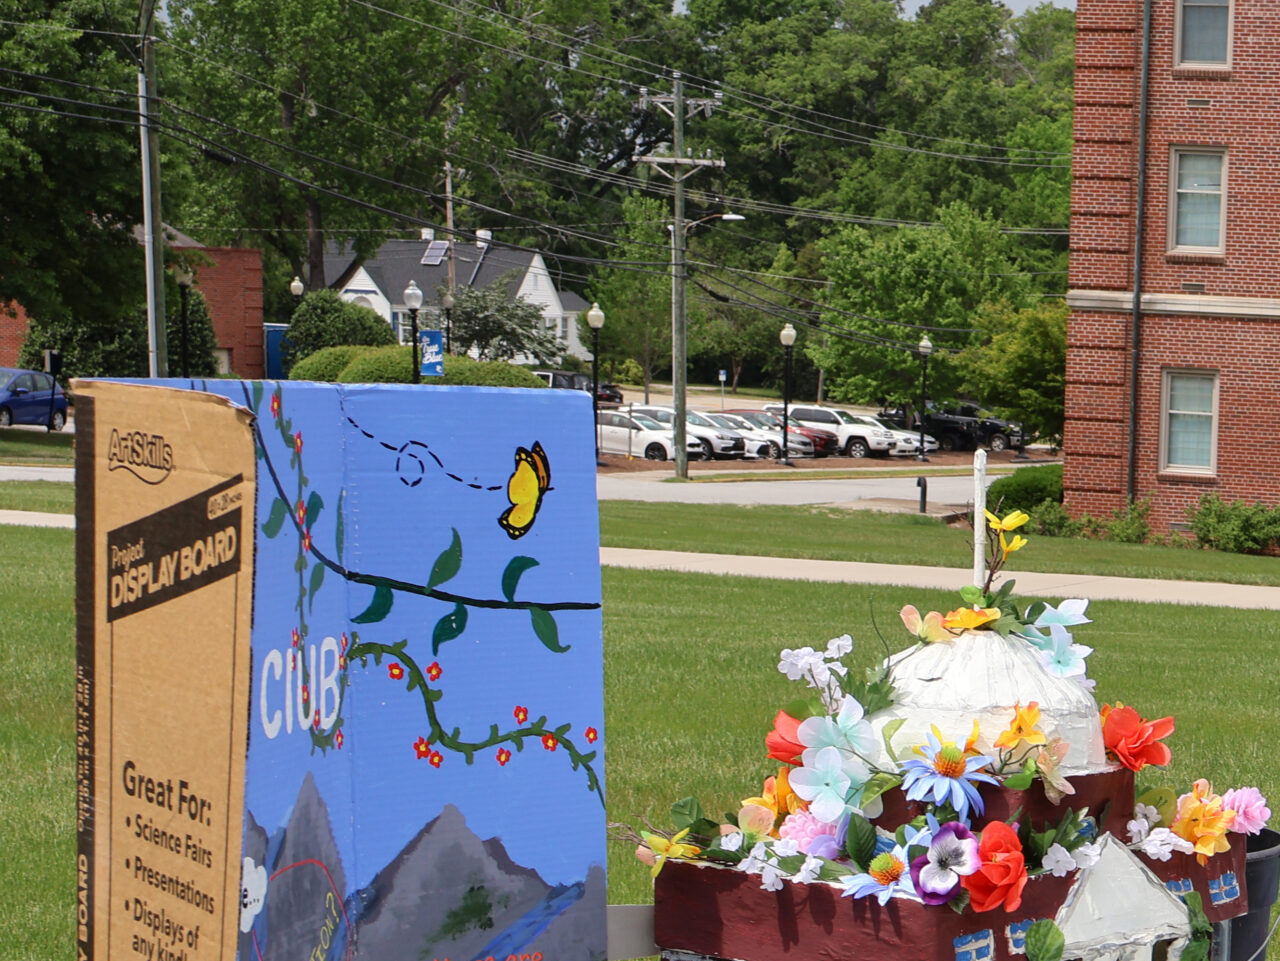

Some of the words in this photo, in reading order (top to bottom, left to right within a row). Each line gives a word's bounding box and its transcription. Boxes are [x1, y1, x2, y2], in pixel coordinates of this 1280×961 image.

[422, 352, 443, 365] Blue
[108, 428, 173, 472] ArtSkills
[111, 537, 145, 571] Project
[111, 551, 179, 608] DISPLAY
[180, 526, 237, 580] BOARD
[122, 760, 173, 811] Great
[177, 780, 212, 827] For:
[134, 814, 182, 854] Science
[184, 833, 213, 868] Fairs
[79, 854, 88, 943] BOARD
[134, 855, 215, 914] Presentations
[133, 897, 184, 946] Displays
[186, 925, 200, 950] of
